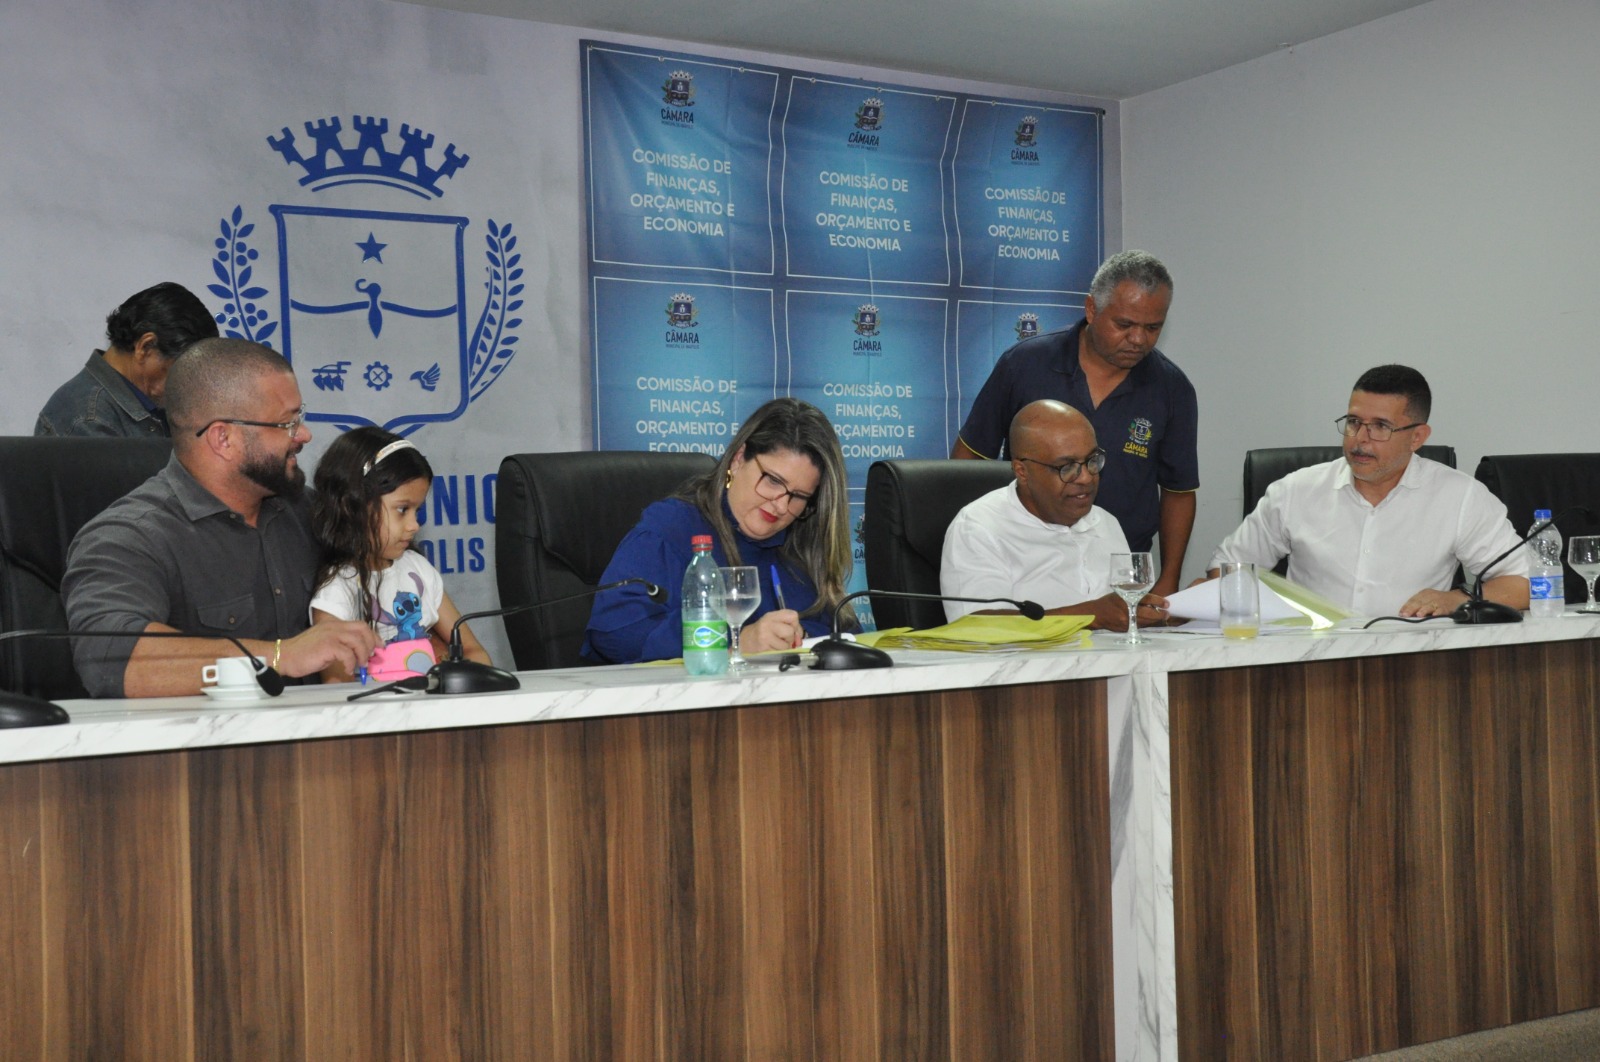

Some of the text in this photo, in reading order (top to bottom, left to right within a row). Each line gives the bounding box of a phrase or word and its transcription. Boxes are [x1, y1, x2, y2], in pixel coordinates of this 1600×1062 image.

[660, 106, 694, 124] CÂMARA
[848, 131, 880, 146] CÂMARA
[632, 148, 732, 174] COMISSÃO DE
[1011, 148, 1039, 161] CÂMARA
[646, 172, 720, 196] FINANÇAS,
[819, 170, 908, 192] COMISSÃO DE
[830, 193, 898, 213] FINANÇAS,
[985, 186, 1066, 204] COMISSÃO DE
[630, 193, 735, 216] ORÇAMENTO E
[816, 213, 911, 232] ORÇAMENTO E
[998, 206, 1056, 224] FINANÇAS,
[643, 216, 724, 237] ECONOMIA
[988, 224, 1069, 242] ORÇAMENTO E
[829, 234, 902, 251] ECONOMIA
[998, 245, 1060, 261] ECONOMIA
[666, 329, 700, 343] CÂMARA
[853, 338, 882, 351] CÂMARA
[636, 376, 737, 393] COMISSÃO DE
[823, 382, 912, 398] COMISSÃO DE
[650, 399, 724, 416] FINANÇAS,
[836, 404, 902, 420] FINANÇAS,
[636, 420, 739, 437] ORÇAMENTO E
[834, 424, 914, 440] RÇAMENTO E
[649, 442, 725, 456] ECONOMIA
[841, 444, 904, 458] CONOMIA
[1125, 442, 1148, 454] CÂMARA
